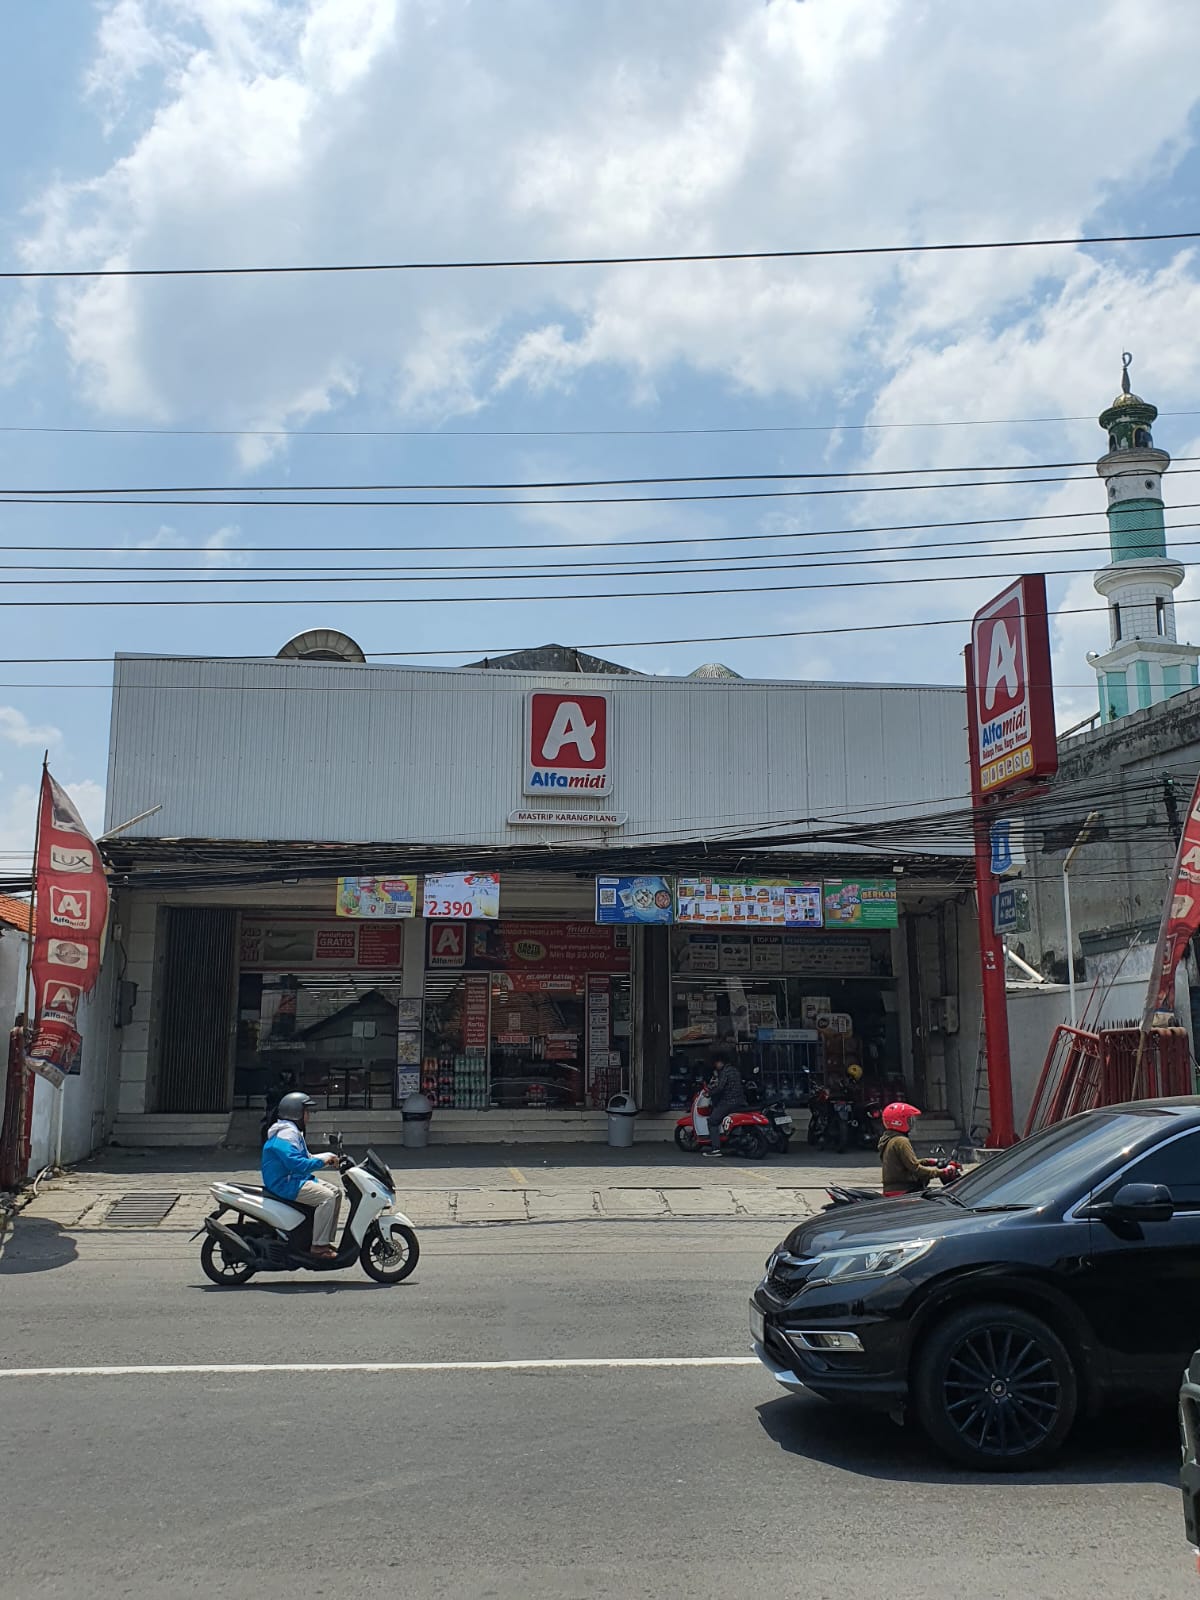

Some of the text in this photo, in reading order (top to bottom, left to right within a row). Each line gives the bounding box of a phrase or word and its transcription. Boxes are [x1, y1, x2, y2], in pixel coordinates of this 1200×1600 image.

[982, 706, 1026, 748] Alfamidi
[530, 771, 607, 789] Alfamidi
[518, 812, 617, 823] MASTRIP KARANGPILANG
[52, 852, 91, 867] LUX
[862, 890, 897, 899] BERKAH
[428, 900, 473, 917] 2.390
[319, 937, 353, 946] GRATIS
